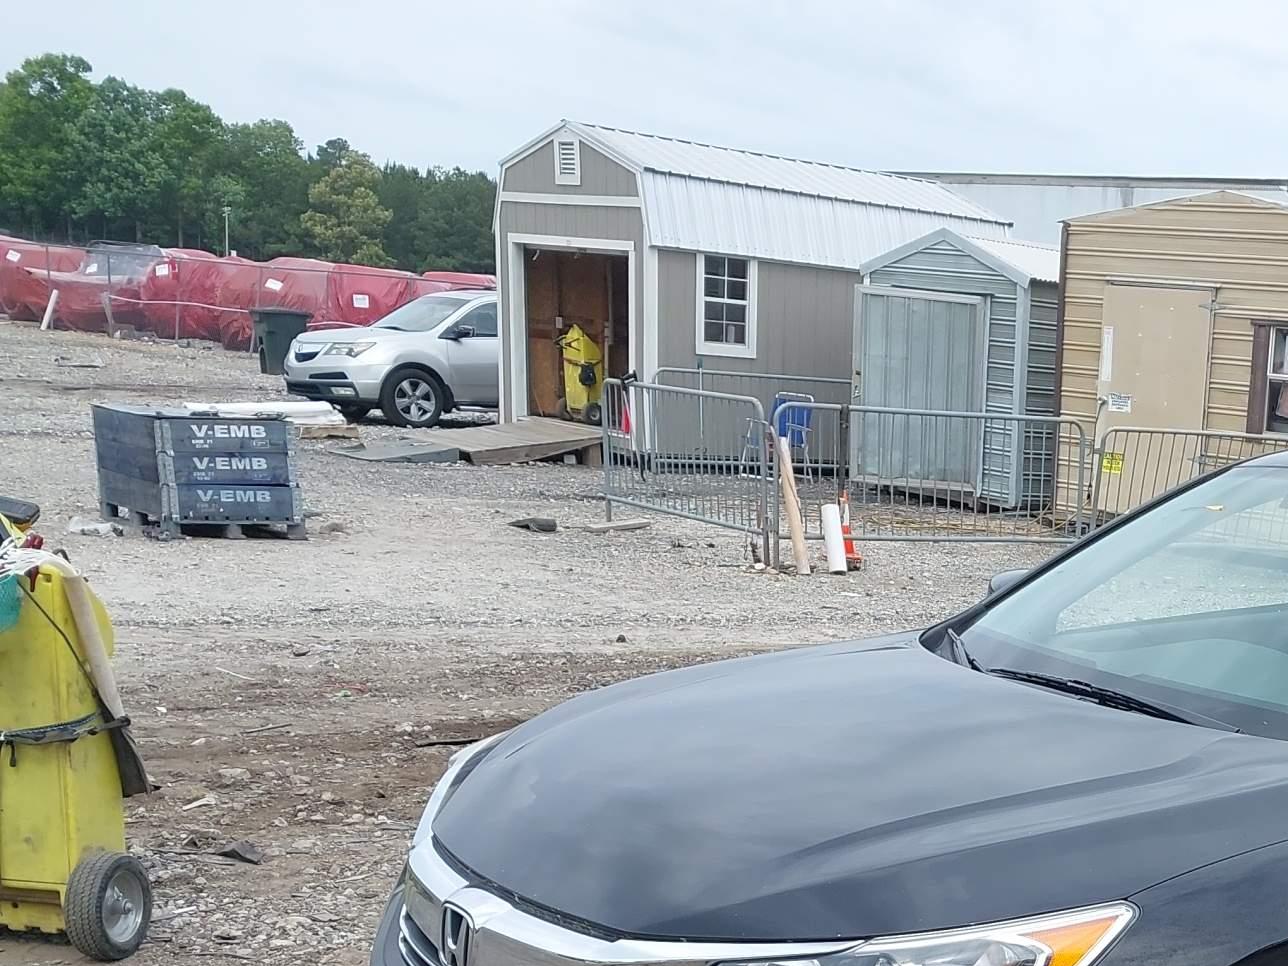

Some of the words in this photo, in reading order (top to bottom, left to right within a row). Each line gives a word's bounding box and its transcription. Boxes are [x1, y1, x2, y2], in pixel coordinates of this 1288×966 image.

[190, 425, 266, 438] V-EMB
[192, 457, 268, 470] V-EMB
[197, 490, 271, 502] V-EMB
